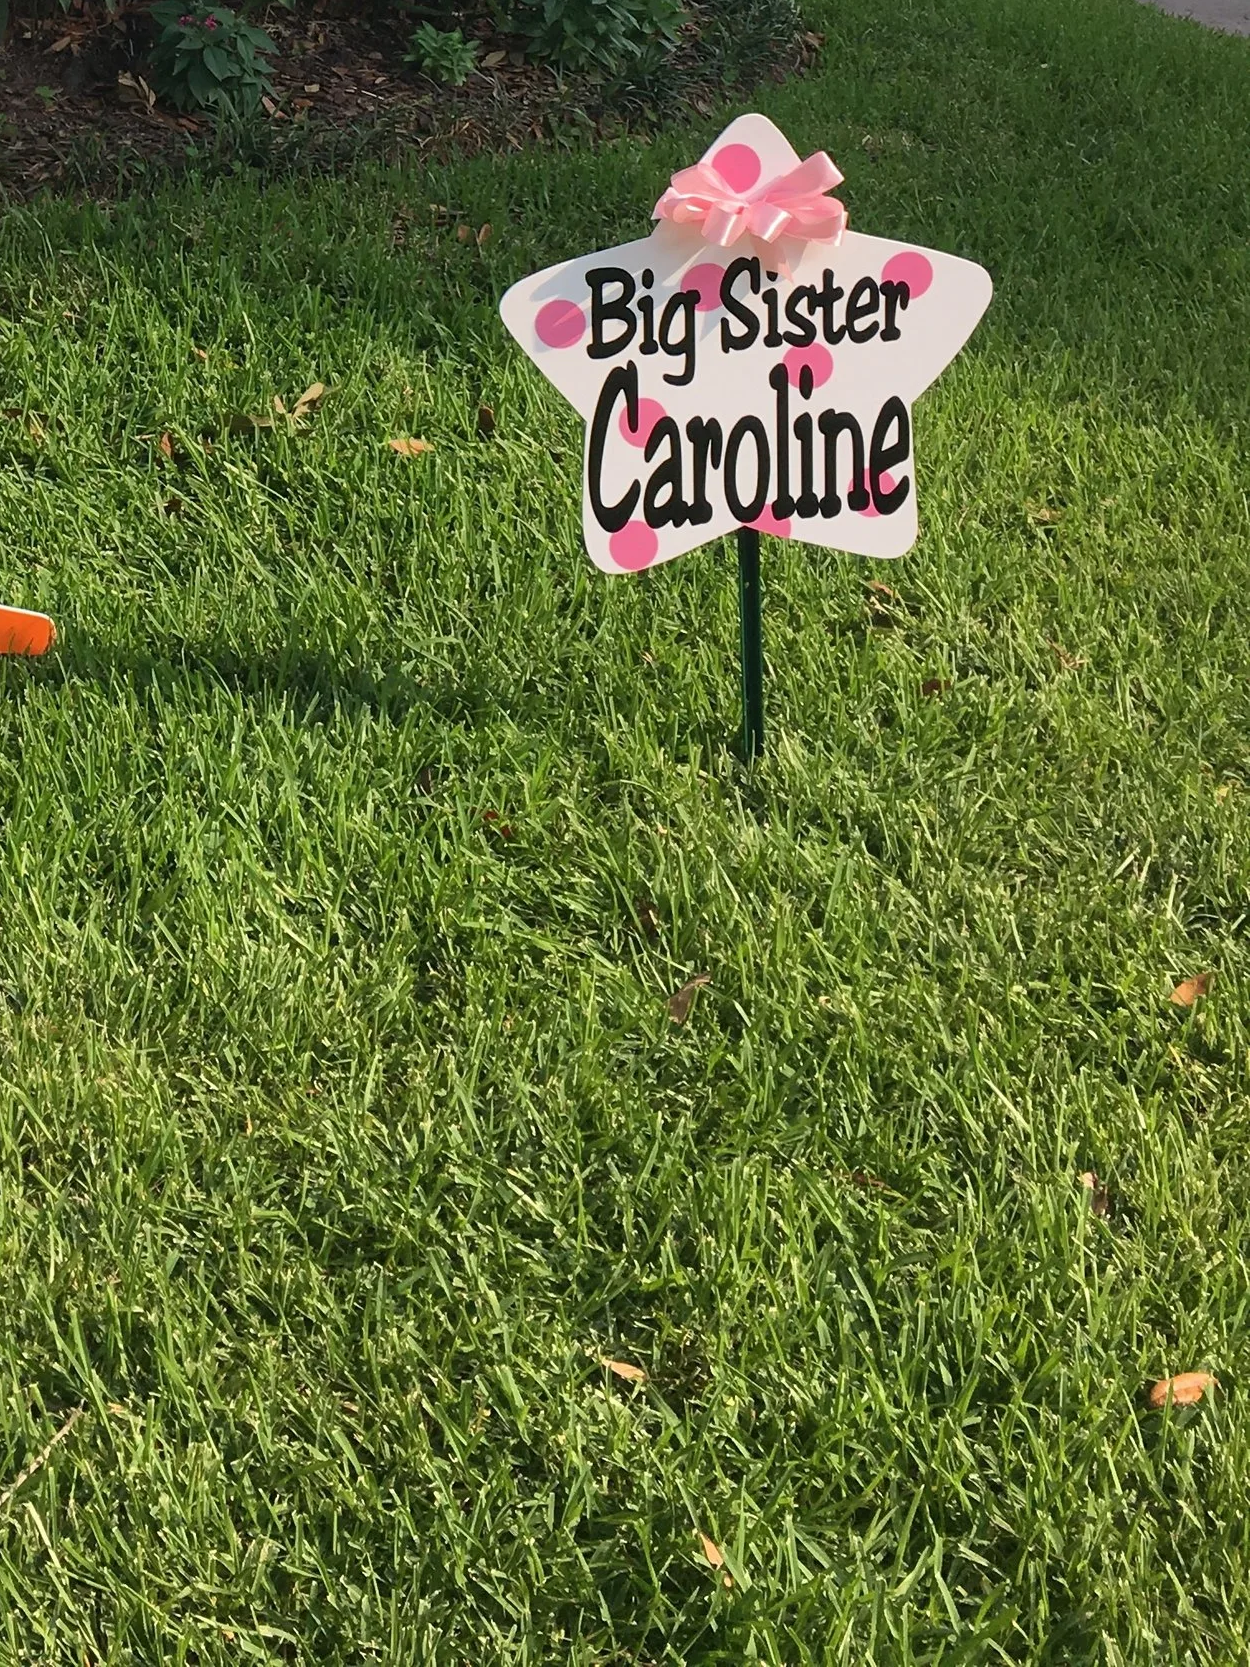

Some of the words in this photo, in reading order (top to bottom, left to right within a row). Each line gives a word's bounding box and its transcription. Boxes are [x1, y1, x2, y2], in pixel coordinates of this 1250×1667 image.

[584, 266, 702, 387] Big
[719, 256, 910, 354] Sister
[587, 359, 911, 534] Caroline
